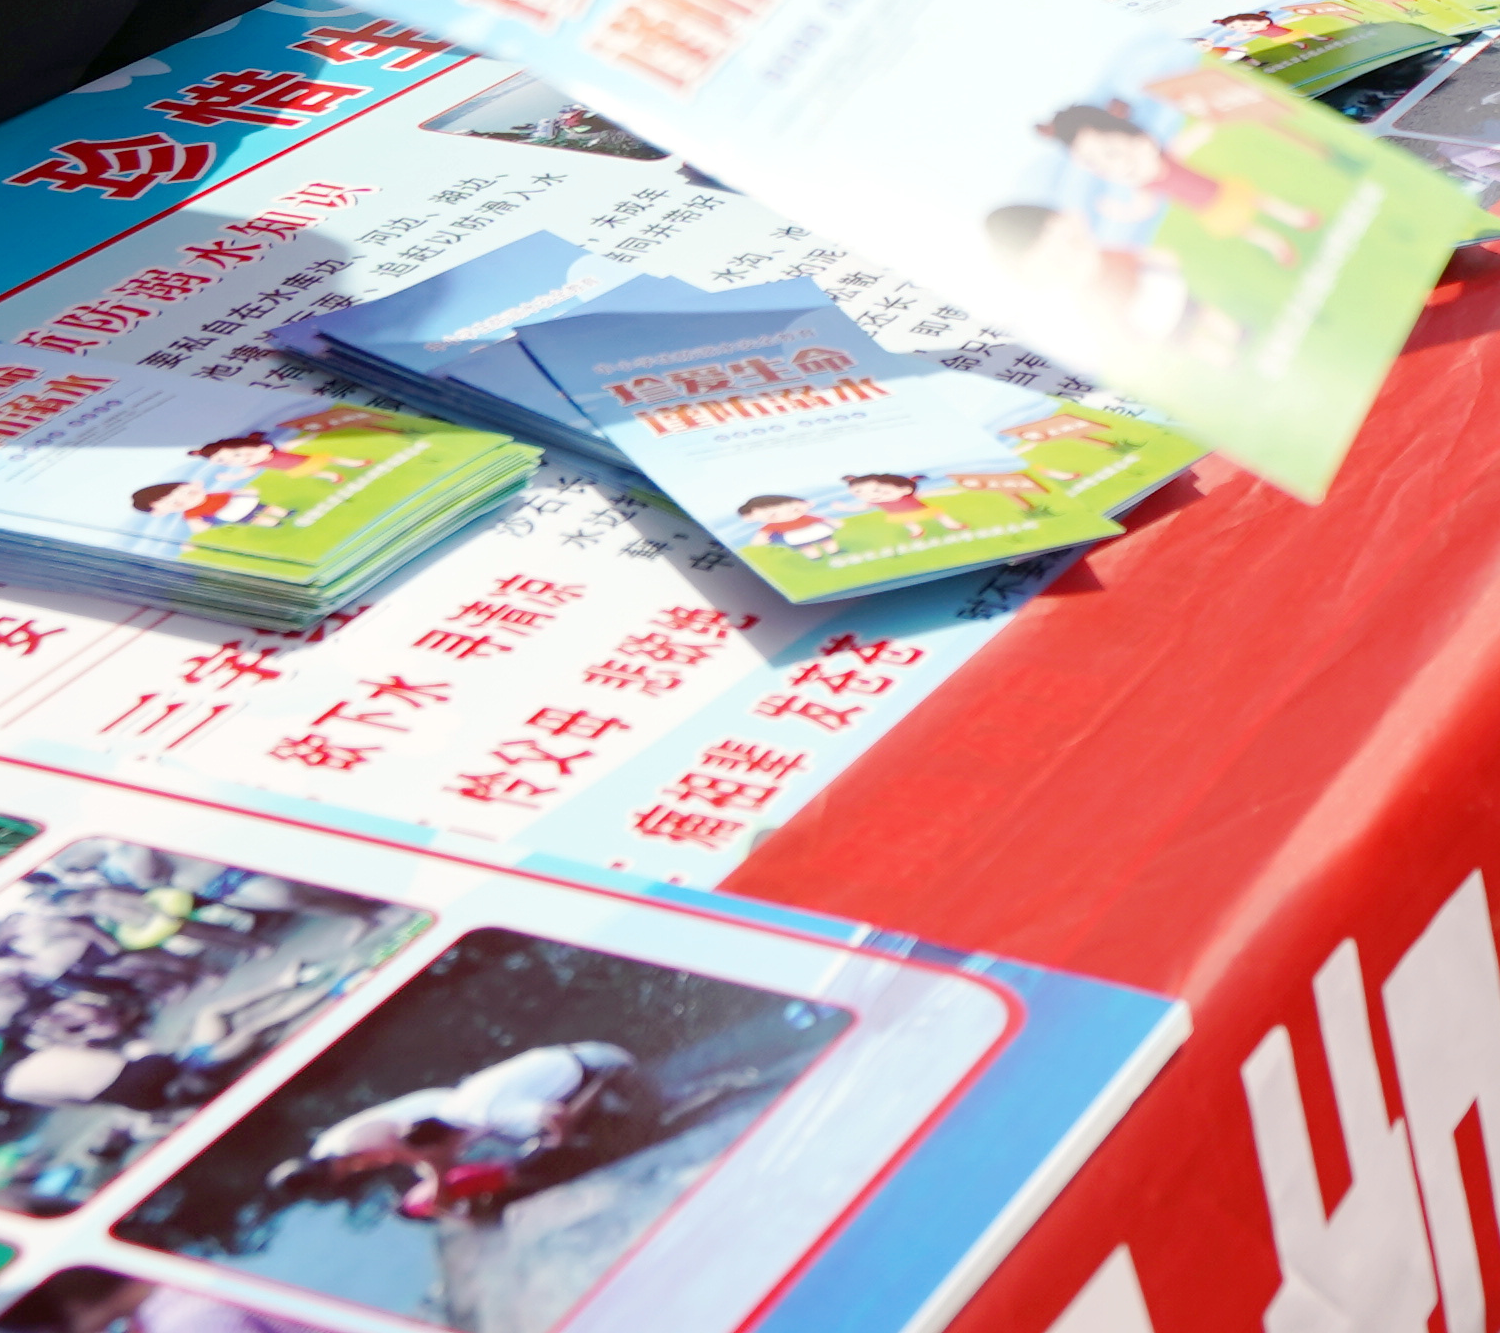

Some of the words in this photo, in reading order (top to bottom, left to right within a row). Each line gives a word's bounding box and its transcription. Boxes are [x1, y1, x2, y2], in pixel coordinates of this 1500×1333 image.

[598, 341, 866, 411] 珍爱生命
[630, 369, 898, 441] 谨防溺水
[257, 667, 466, 777] 欲下水
[404, 569, 595, 665] 寻清凉
[437, 701, 639, 813] 怜父母
[571, 598, 763, 700] 悲欲绝
[614, 735, 819, 853] 痛祖辈
[744, 628, 932, 735] 发苍苍
